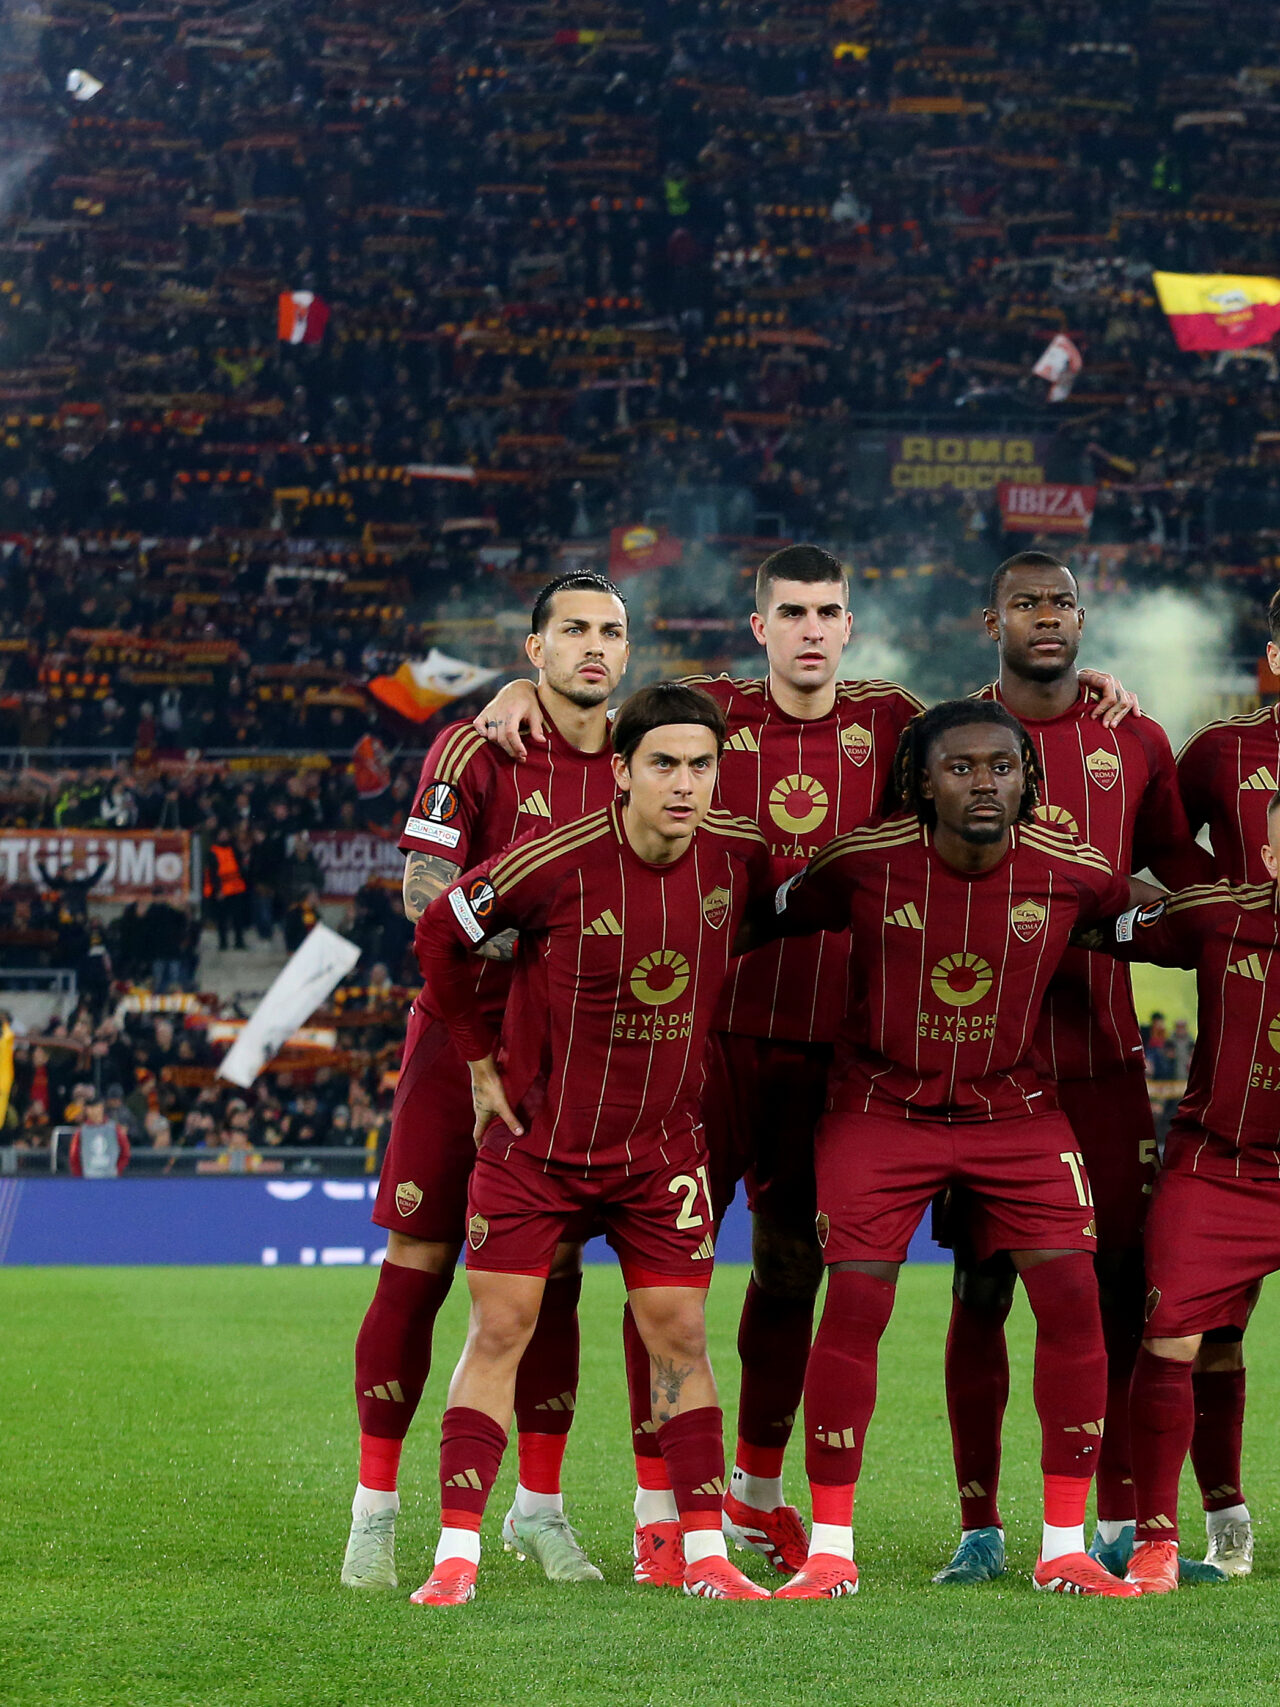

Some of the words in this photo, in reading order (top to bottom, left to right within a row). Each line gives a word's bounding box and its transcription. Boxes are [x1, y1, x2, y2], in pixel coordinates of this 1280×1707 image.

[903, 436, 1034, 463] ROMA
[1008, 486, 1087, 515] IBIZA
[1094, 771, 1115, 779] ROMA
[408, 822, 458, 842] FOUNDATION
[771, 843, 820, 858] IYAD
[1017, 923, 1038, 931] ROMA
[615, 1010, 692, 1026] RIYADH
[919, 1012, 997, 1028] RIYADH
[613, 1025, 691, 1041] SEASON
[917, 1026, 995, 1042] SEASON
[1139, 1139, 1160, 1194] 5
[668, 1165, 714, 1230] 21
